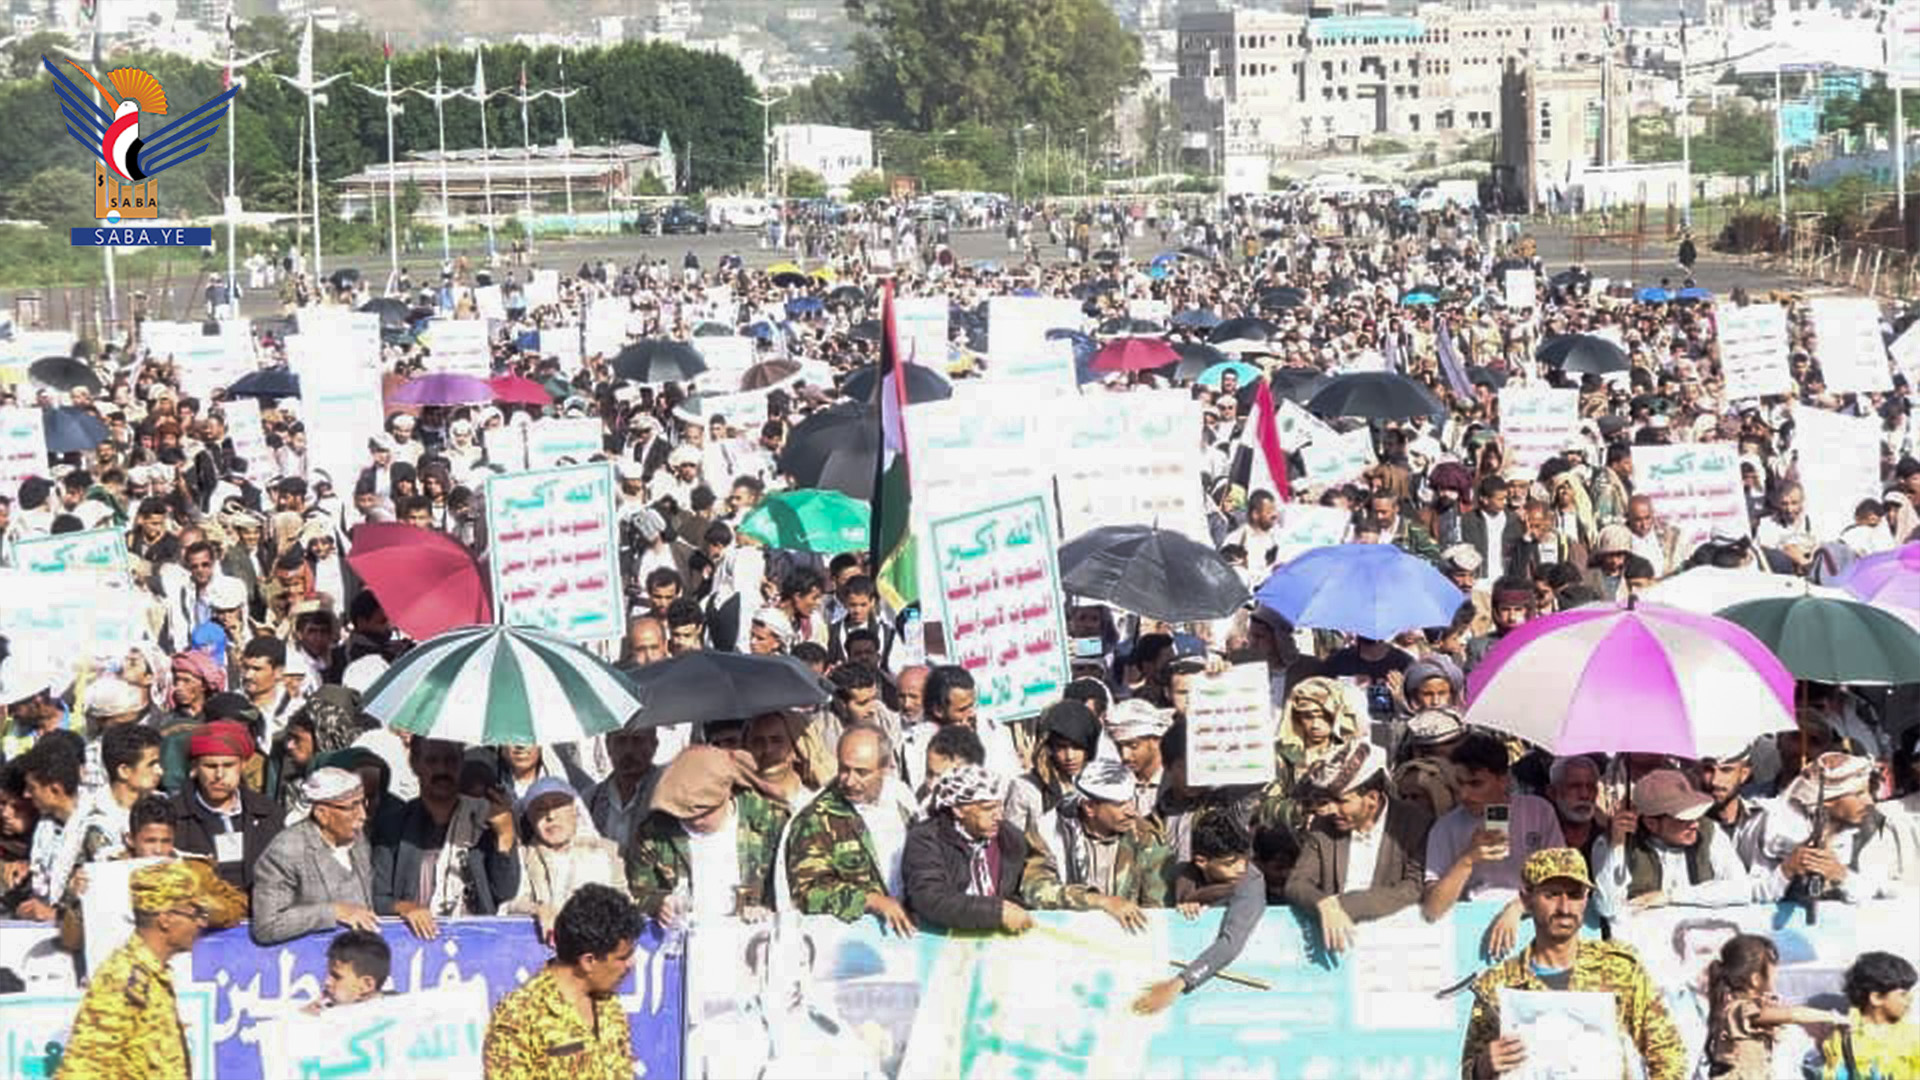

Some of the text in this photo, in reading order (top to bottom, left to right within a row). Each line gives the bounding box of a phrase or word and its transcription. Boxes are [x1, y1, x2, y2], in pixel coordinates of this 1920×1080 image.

[563, 478, 607, 504] الله
[1004, 511, 1043, 547] الله
[405, 1018, 479, 1062] الله
